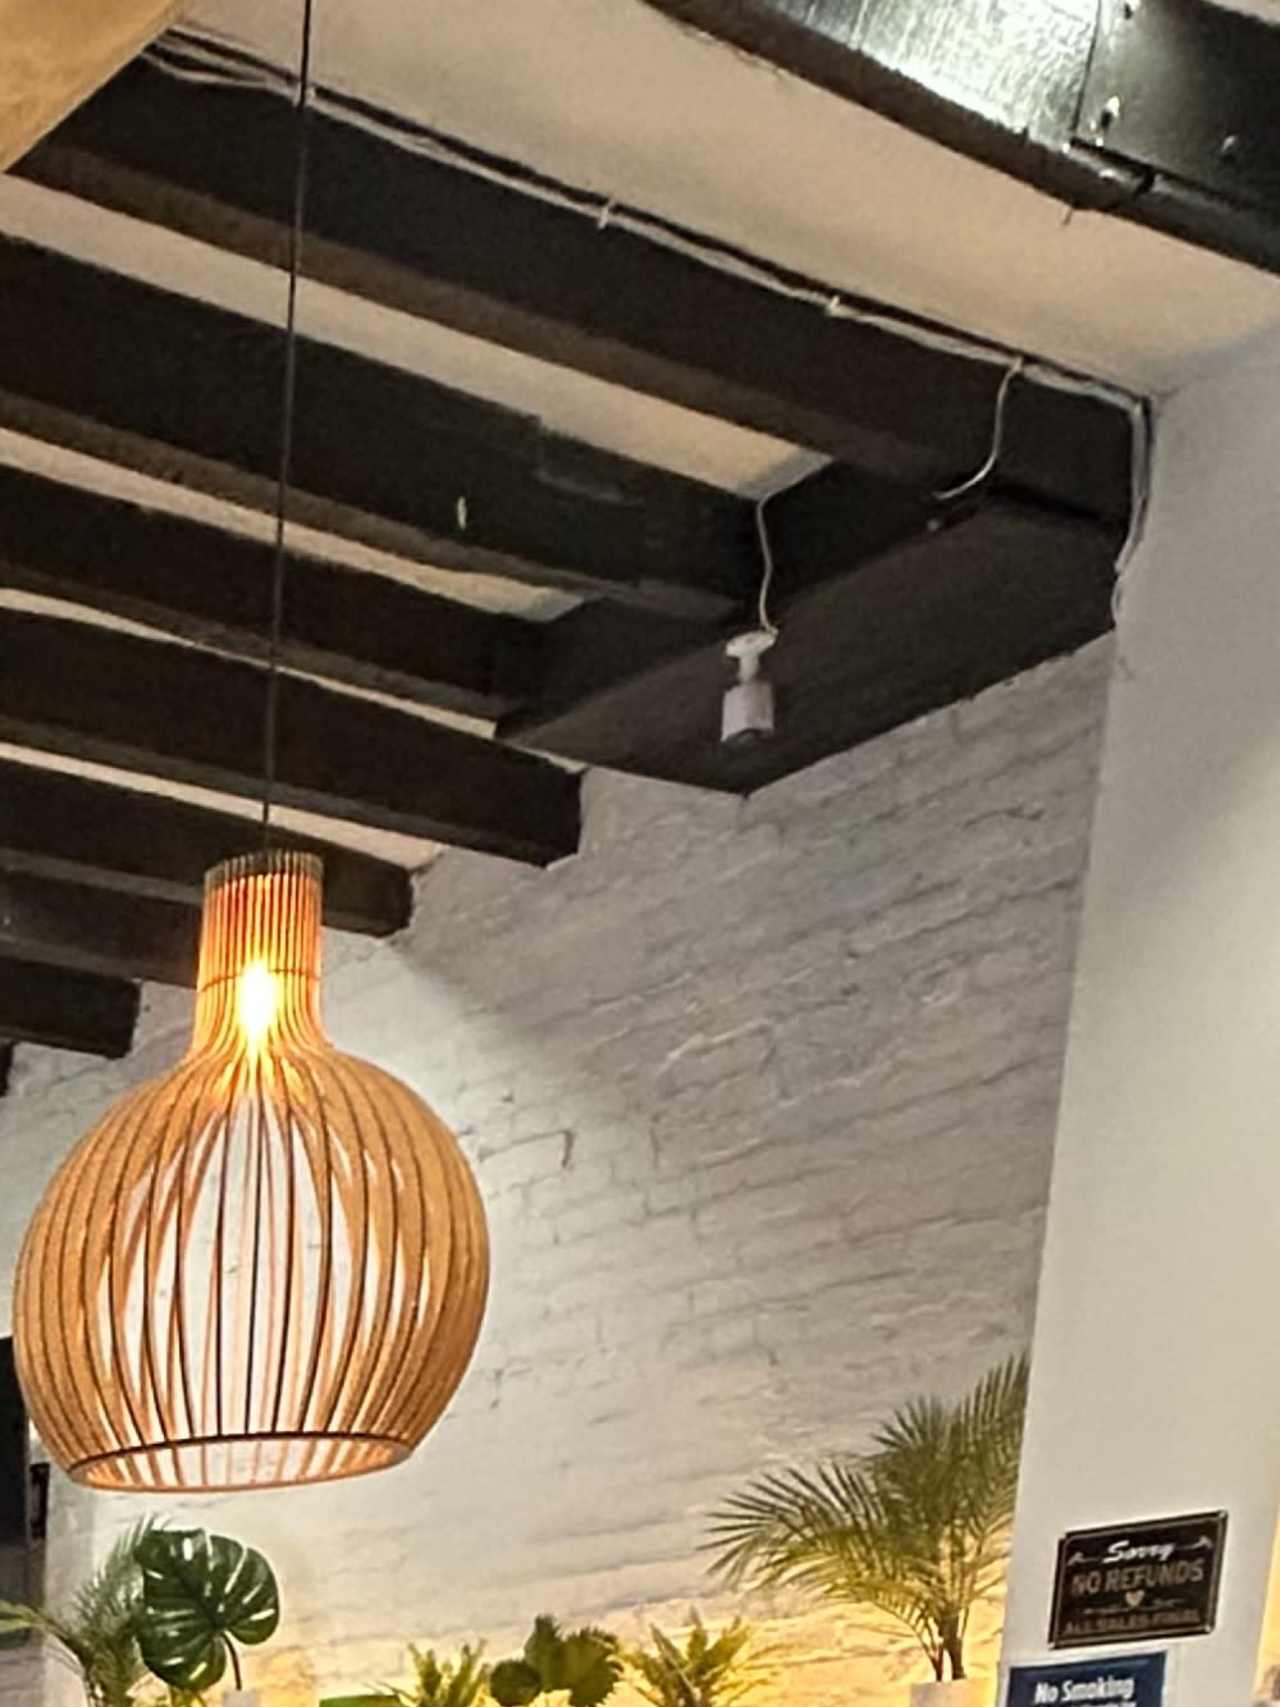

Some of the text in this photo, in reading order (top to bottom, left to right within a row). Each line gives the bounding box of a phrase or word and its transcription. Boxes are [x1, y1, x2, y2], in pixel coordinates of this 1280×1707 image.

[1102, 1540, 1176, 1564] Sorry
[1071, 1558, 1205, 1597] NO REFUNDS
[1034, 1675, 1135, 1704] No Smoking
